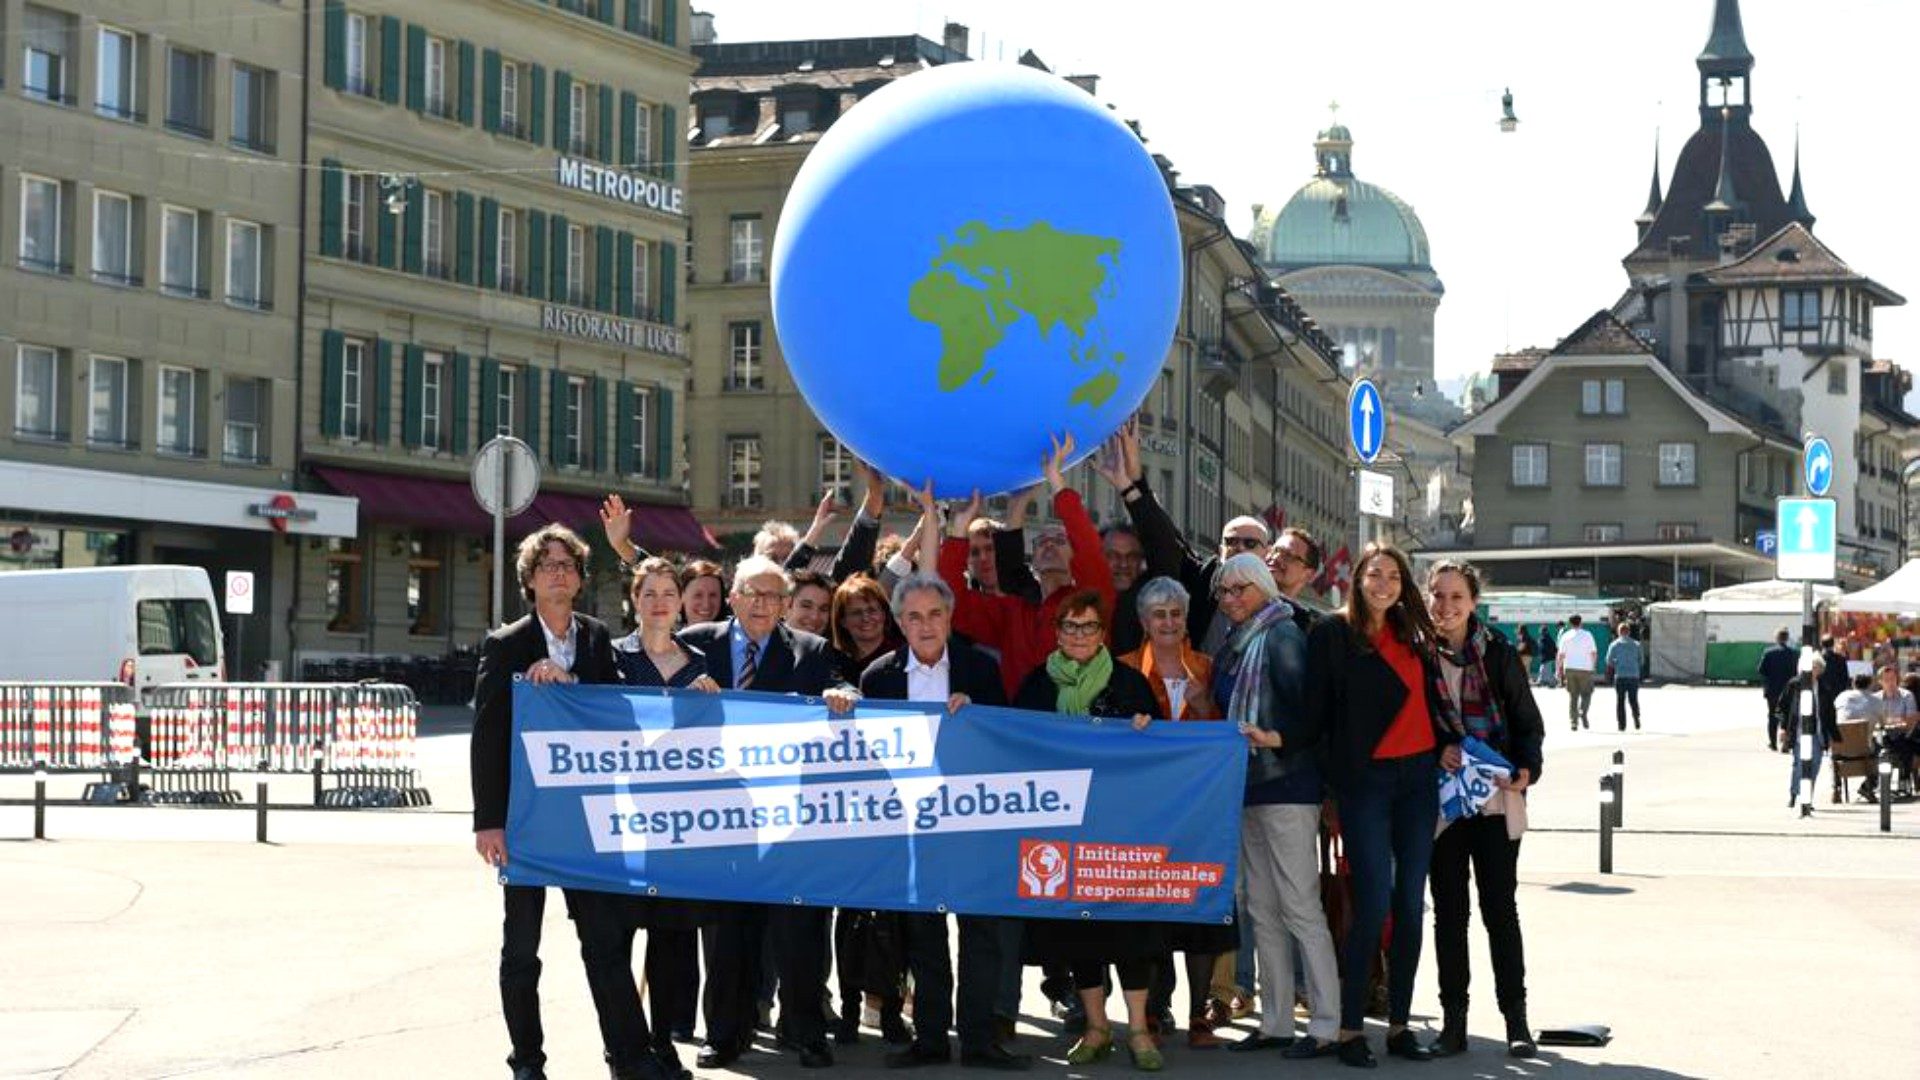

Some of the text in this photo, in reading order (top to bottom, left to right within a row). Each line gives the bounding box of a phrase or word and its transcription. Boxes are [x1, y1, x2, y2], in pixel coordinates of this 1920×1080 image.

[559, 158, 683, 214] METROPOLE
[1764, 538, 1774, 553] P
[547, 727, 916, 775] Business mondial,
[610, 780, 1071, 842] responsabilité globale.
[1077, 846, 1163, 863] Initiative
[1076, 864, 1217, 882] multinationales
[1076, 883, 1192, 900] responsables
